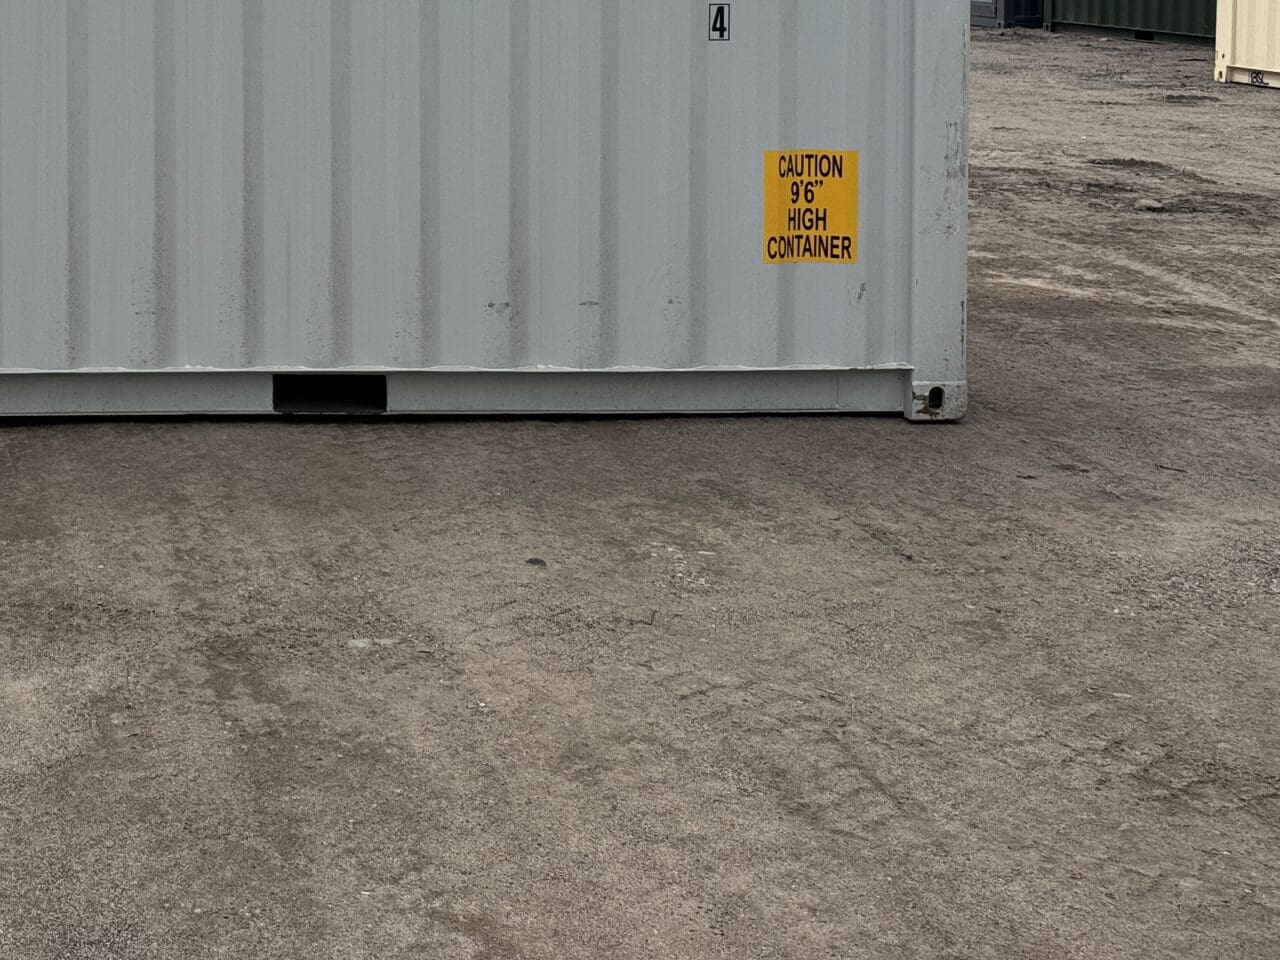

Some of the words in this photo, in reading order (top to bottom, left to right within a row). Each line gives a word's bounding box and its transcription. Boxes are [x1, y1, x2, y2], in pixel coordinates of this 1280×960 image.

[711, 5, 728, 38] 4
[778, 154, 843, 178] CAUTION
[787, 208, 827, 231] HIGH
[767, 234, 852, 259] CONTAINER
